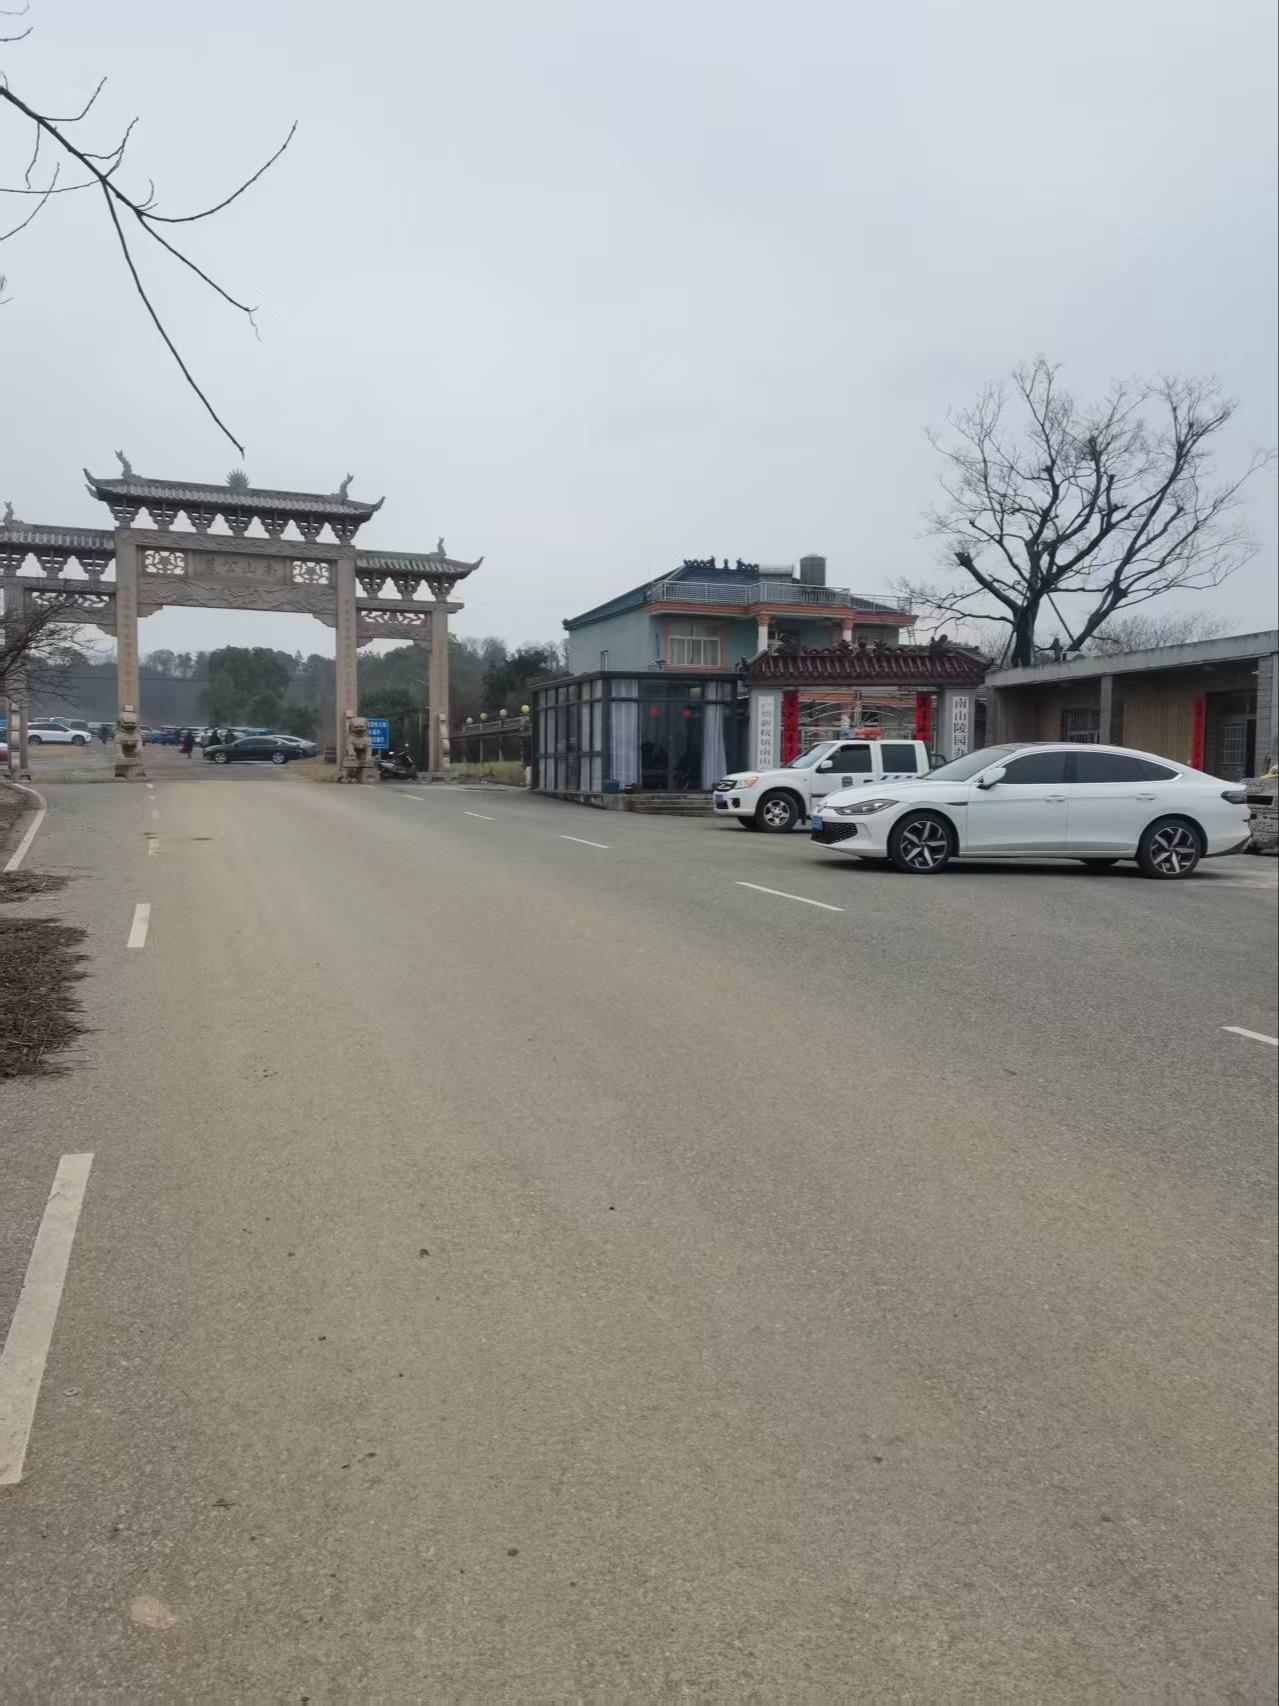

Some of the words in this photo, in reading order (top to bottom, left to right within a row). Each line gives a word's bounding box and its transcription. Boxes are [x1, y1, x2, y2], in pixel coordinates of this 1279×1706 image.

[952, 697, 968, 757] 南山陵园办
